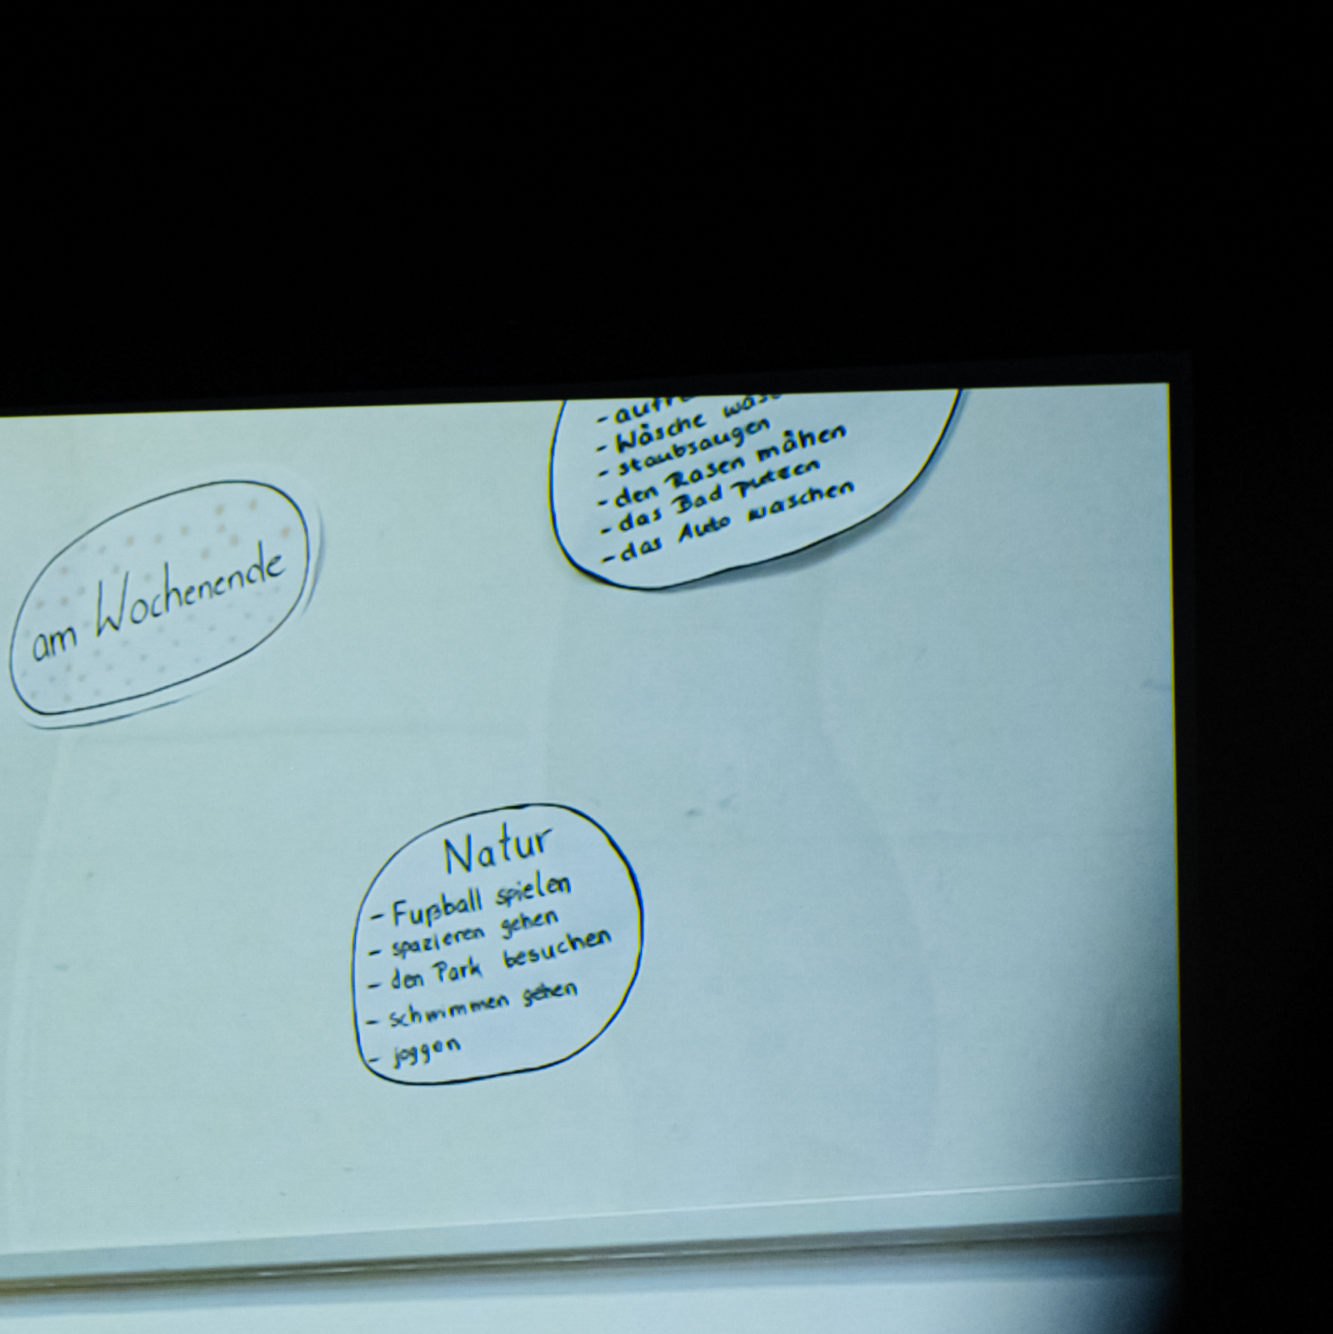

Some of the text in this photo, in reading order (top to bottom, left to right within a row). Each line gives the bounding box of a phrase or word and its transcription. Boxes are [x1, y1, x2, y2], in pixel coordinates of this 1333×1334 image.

[614, 397, 695, 424] aufr
[615, 414, 707, 454] Wäsche
[614, 424, 848, 508] den Rasen mähen
[618, 418, 771, 476] staubsaugen
[618, 507, 662, 533] das
[670, 484, 723, 515] Bad
[620, 480, 856, 562] das Auto waschen
[32, 539, 287, 662] am Wochenende
[443, 821, 553, 875] Natur
[495, 869, 572, 908] spielen
[390, 928, 612, 990] den Park besuchen
[391, 908, 559, 960] spazieren gehen
[388, 981, 578, 1028] schwimmen gehen
[392, 1037, 461, 1070] joggen
